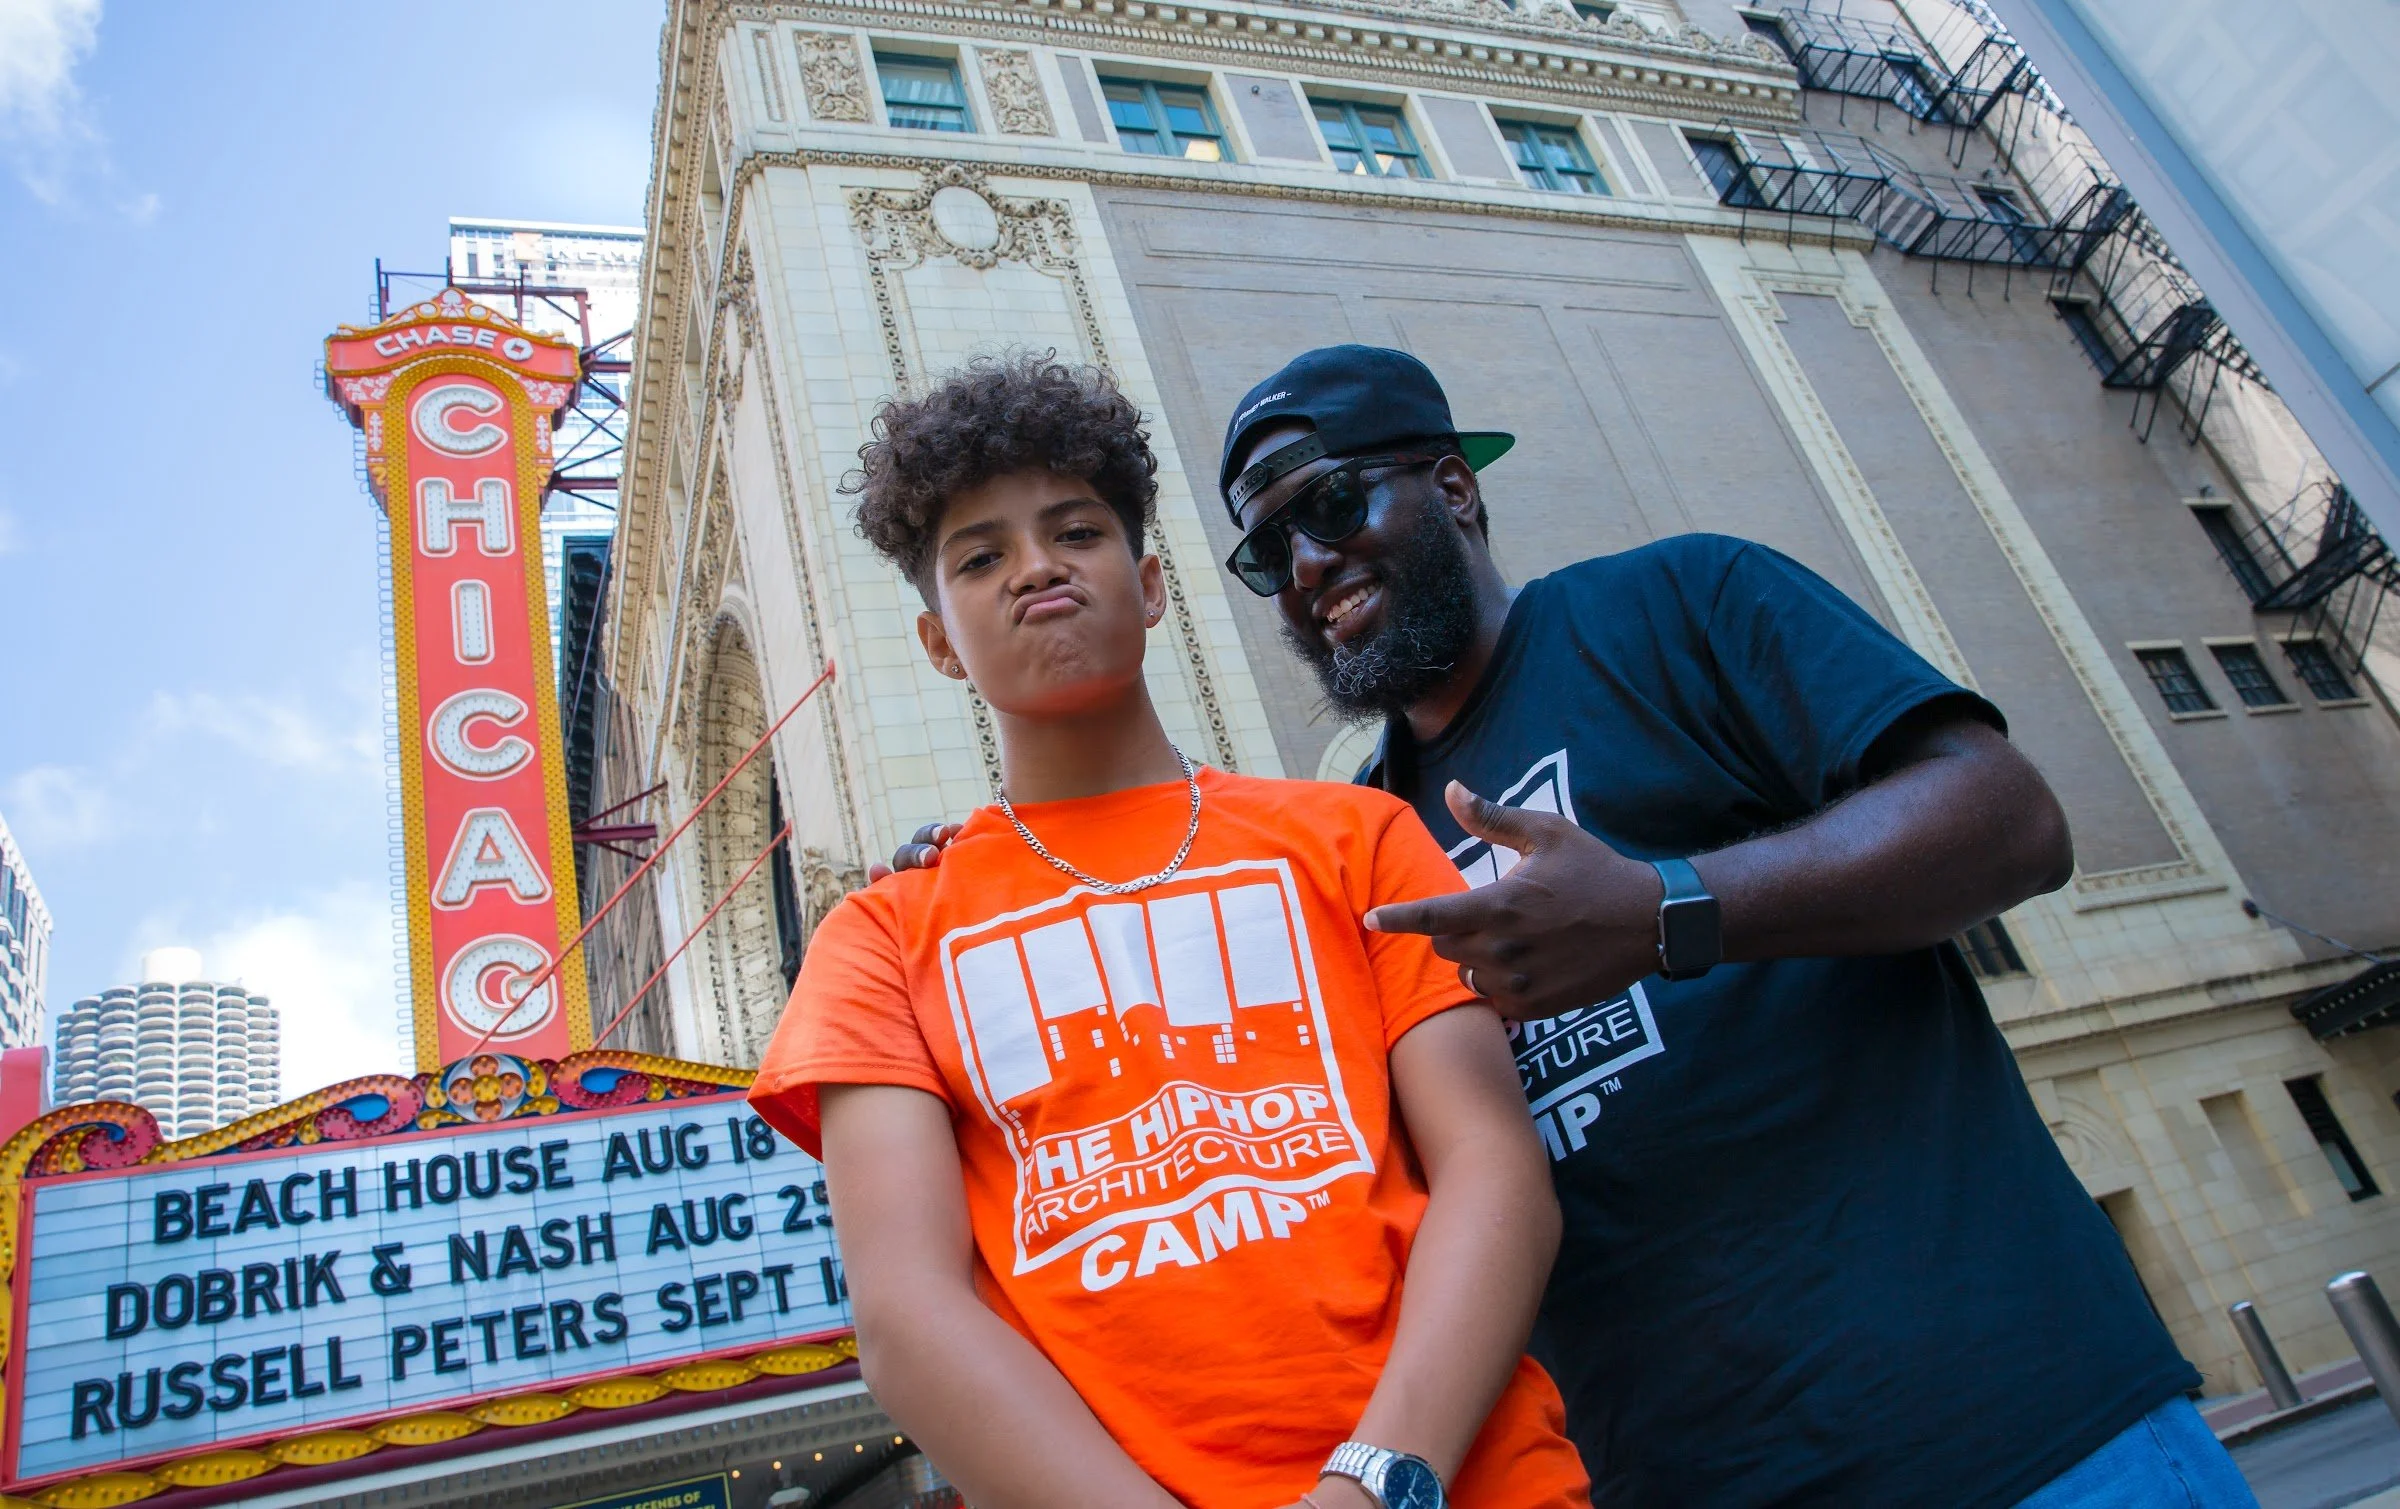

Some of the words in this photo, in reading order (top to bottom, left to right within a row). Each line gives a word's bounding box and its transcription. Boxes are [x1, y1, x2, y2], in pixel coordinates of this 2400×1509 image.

[374, 325, 499, 358] CHASE
[154, 1166, 358, 1246] BEACH
[384, 1140, 574, 1212] HOUSE
[602, 1123, 709, 1183] AUG
[728, 1114, 776, 1164] 18
[1024, 1128, 1351, 1245] ARCHITECTURE
[106, 1251, 346, 1341] DOBRIK
[370, 1242, 412, 1297] &
[449, 1211, 617, 1284] NASH
[647, 1192, 754, 1255] AUG
[71, 1336, 362, 1441] RUSSELL
[392, 1292, 628, 1382] PETERS
[657, 1263, 794, 1333] SEPT
[683, 1491, 701, 1505] OF
